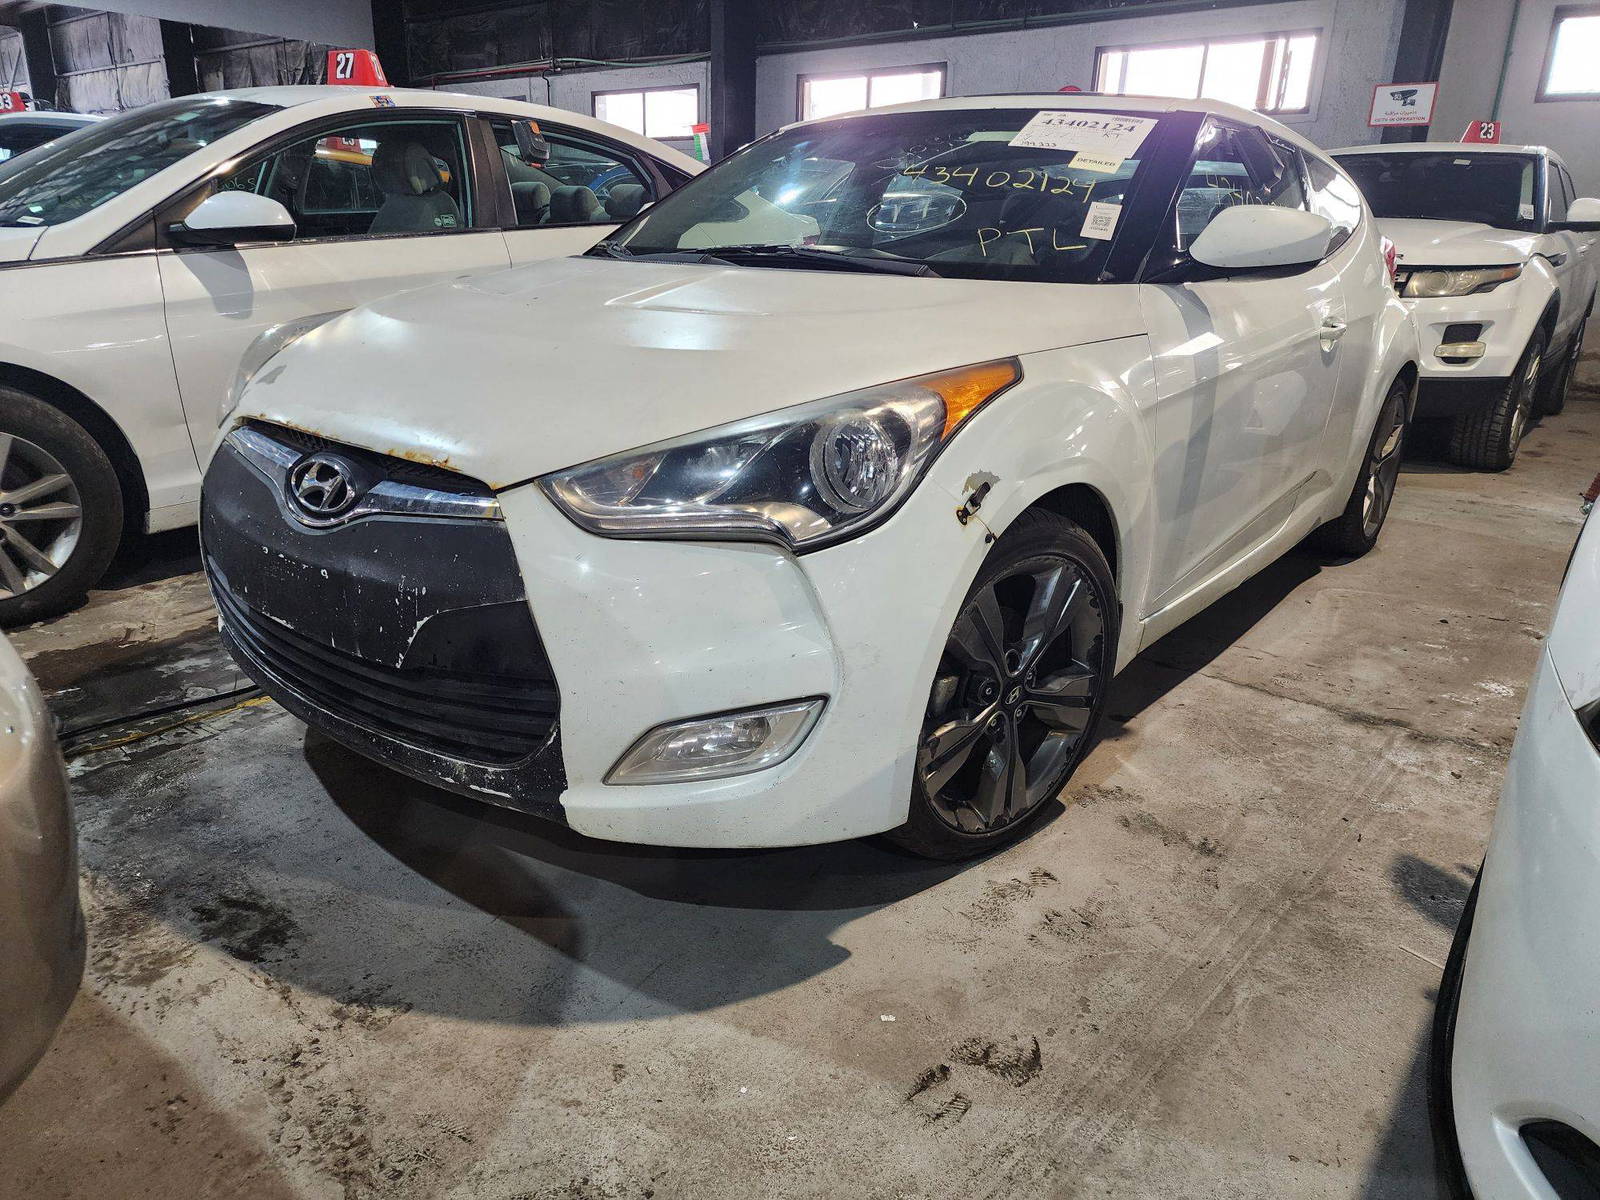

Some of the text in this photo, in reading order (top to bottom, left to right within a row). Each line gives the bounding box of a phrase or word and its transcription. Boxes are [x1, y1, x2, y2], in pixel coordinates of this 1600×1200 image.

[336, 52, 354, 79] 27
[1042, 118, 1136, 133] 43402124
[1479, 122, 1495, 139] 23
[1076, 156, 1116, 167] DETAILED
[904, 164, 1096, 203] 43402124
[977, 227, 1088, 256] PTL
